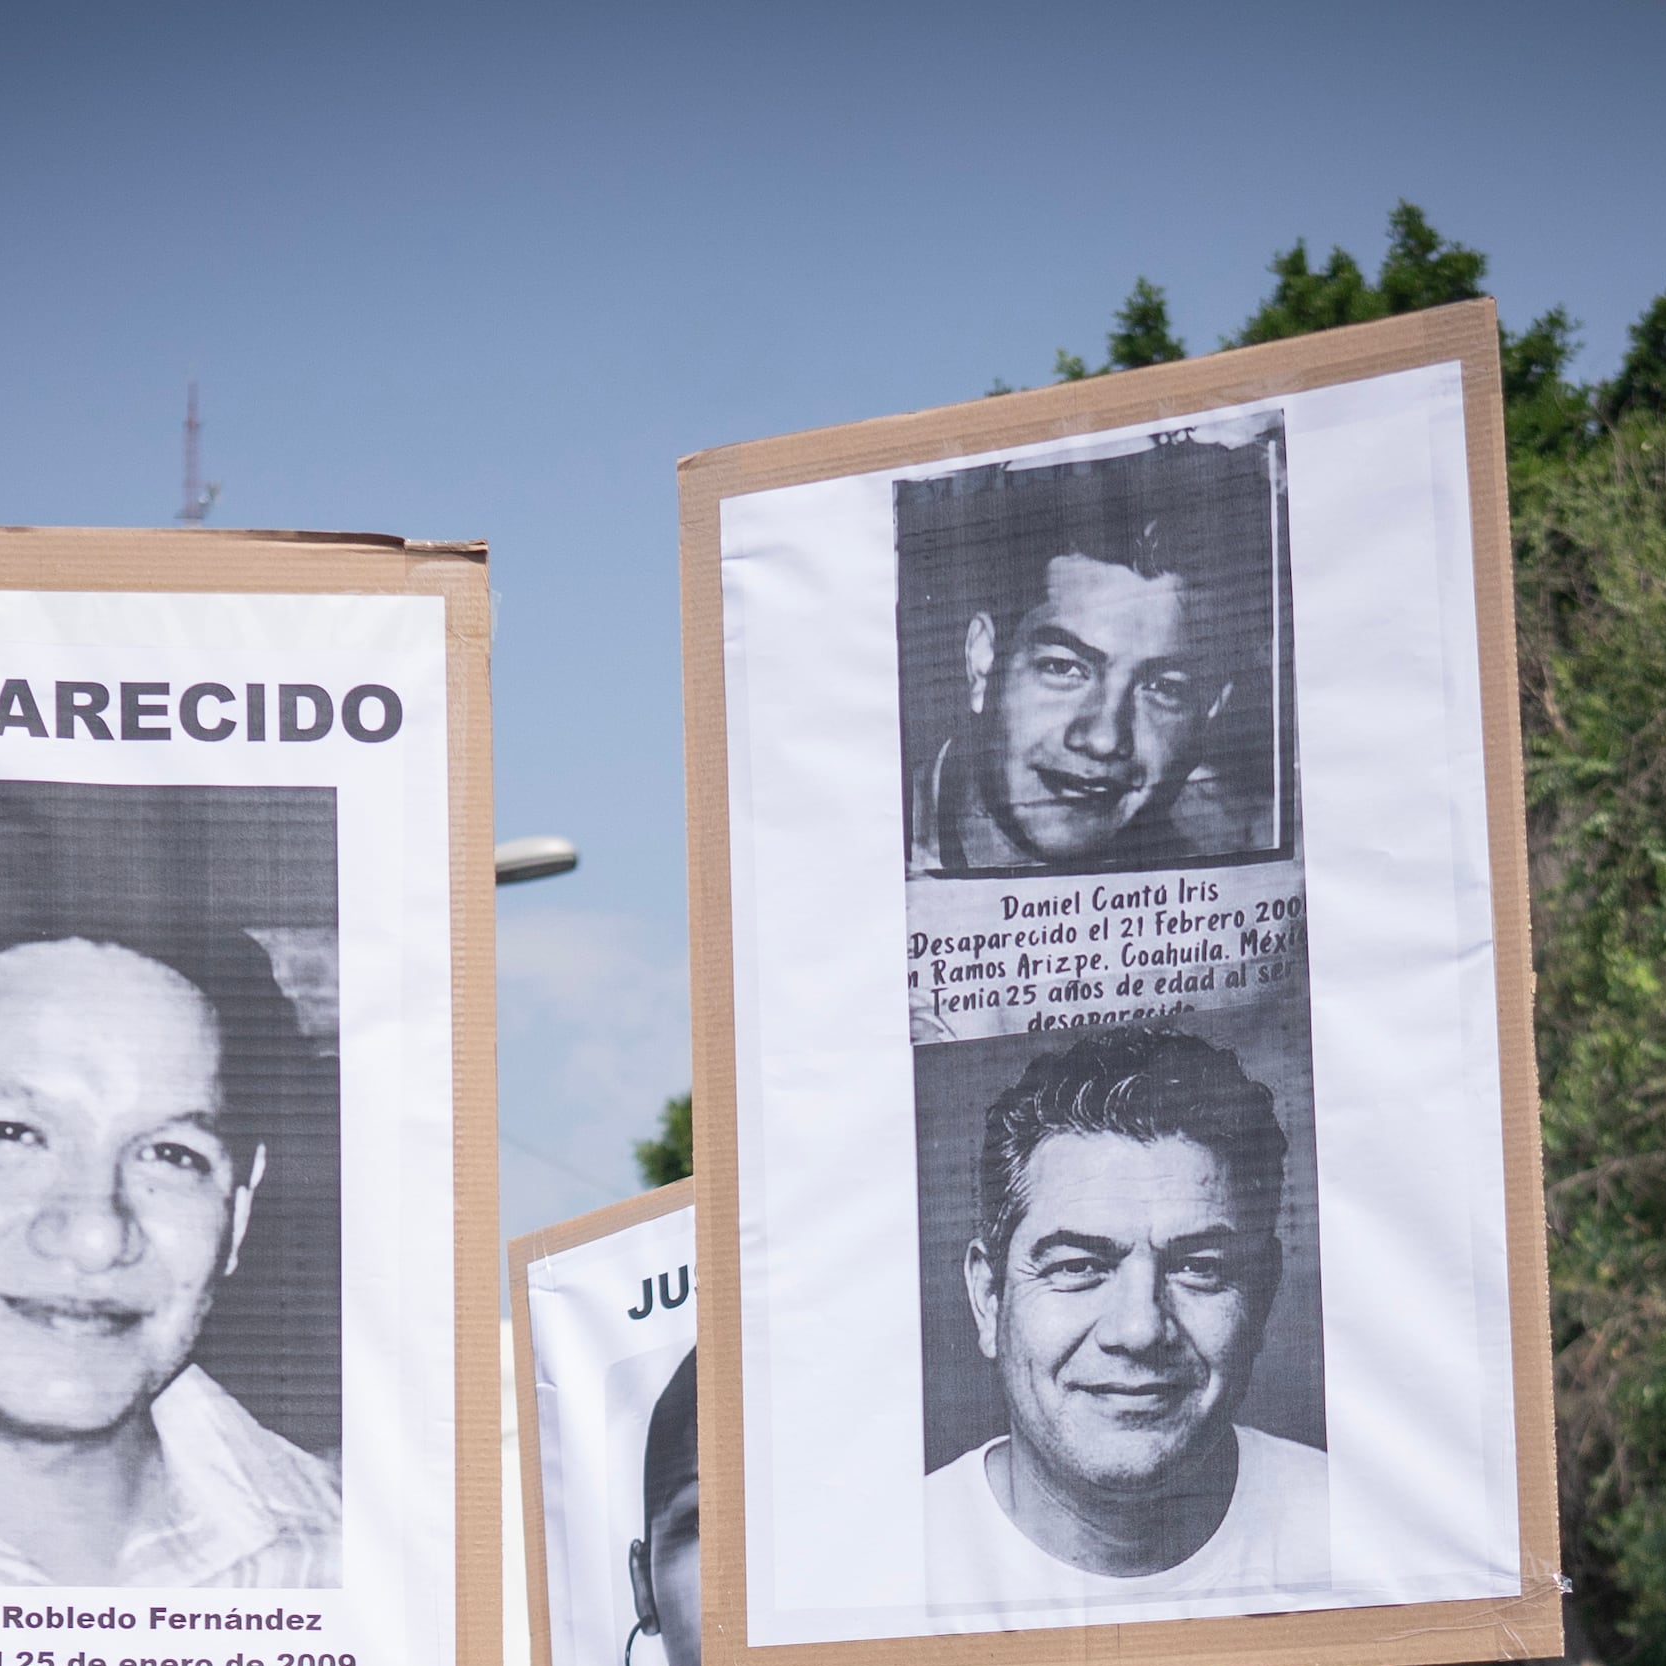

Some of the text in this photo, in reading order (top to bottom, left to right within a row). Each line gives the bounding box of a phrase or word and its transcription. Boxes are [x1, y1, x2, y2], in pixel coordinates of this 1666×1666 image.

[1000, 890, 1080, 921] Daniel
[1178, 877, 1219, 904] Iris
[910, 922, 1077, 960] Desaparecido
[1088, 916, 1109, 942] el
[1120, 916, 1144, 939] 21
[1155, 909, 1245, 937] Febrero
[930, 959, 1006, 986] Ramos
[930, 986, 1001, 1017] Tenia
[1006, 984, 1037, 1007] 25
[1047, 978, 1105, 1004] años
[1115, 972, 1145, 998] de
[1153, 966, 1216, 996] edad
[1224, 962, 1248, 990] al
[2, 1606, 136, 1630] Robledo
[149, 1607, 322, 1631] Fernández
